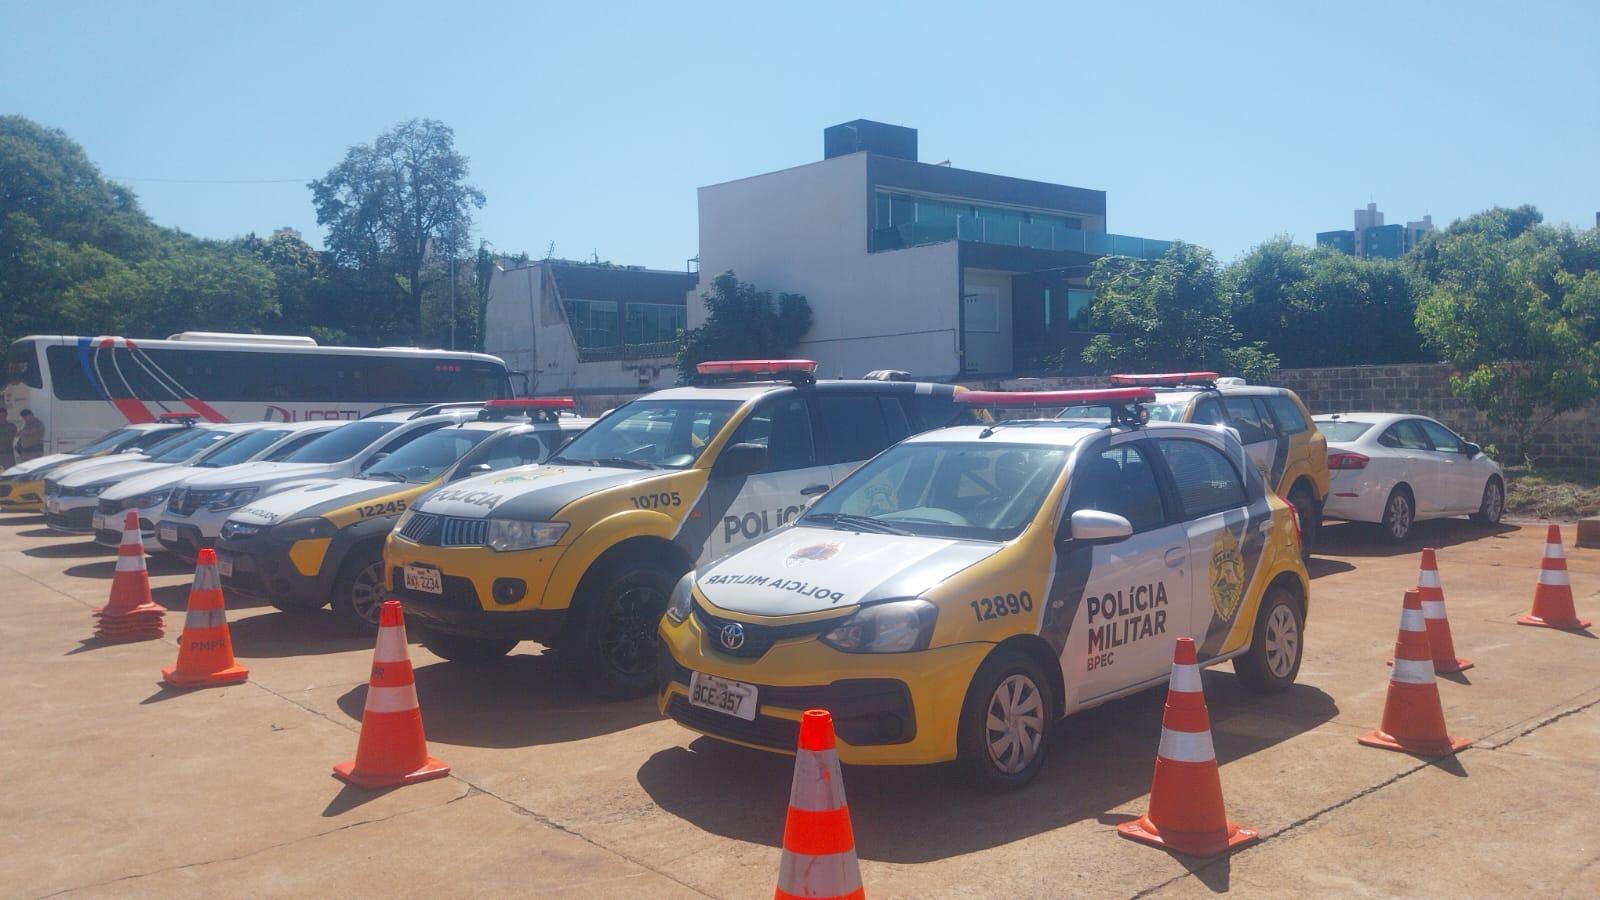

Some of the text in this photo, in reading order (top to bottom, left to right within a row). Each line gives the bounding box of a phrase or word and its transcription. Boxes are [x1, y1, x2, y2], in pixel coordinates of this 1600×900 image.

[357, 500, 407, 519] 12245
[631, 491, 682, 510] 10705
[724, 504, 807, 544] POLÍC
[970, 591, 1033, 623] 12890
[1087, 610, 1167, 655] MILITAR
[1087, 652, 1114, 672] BPEC
